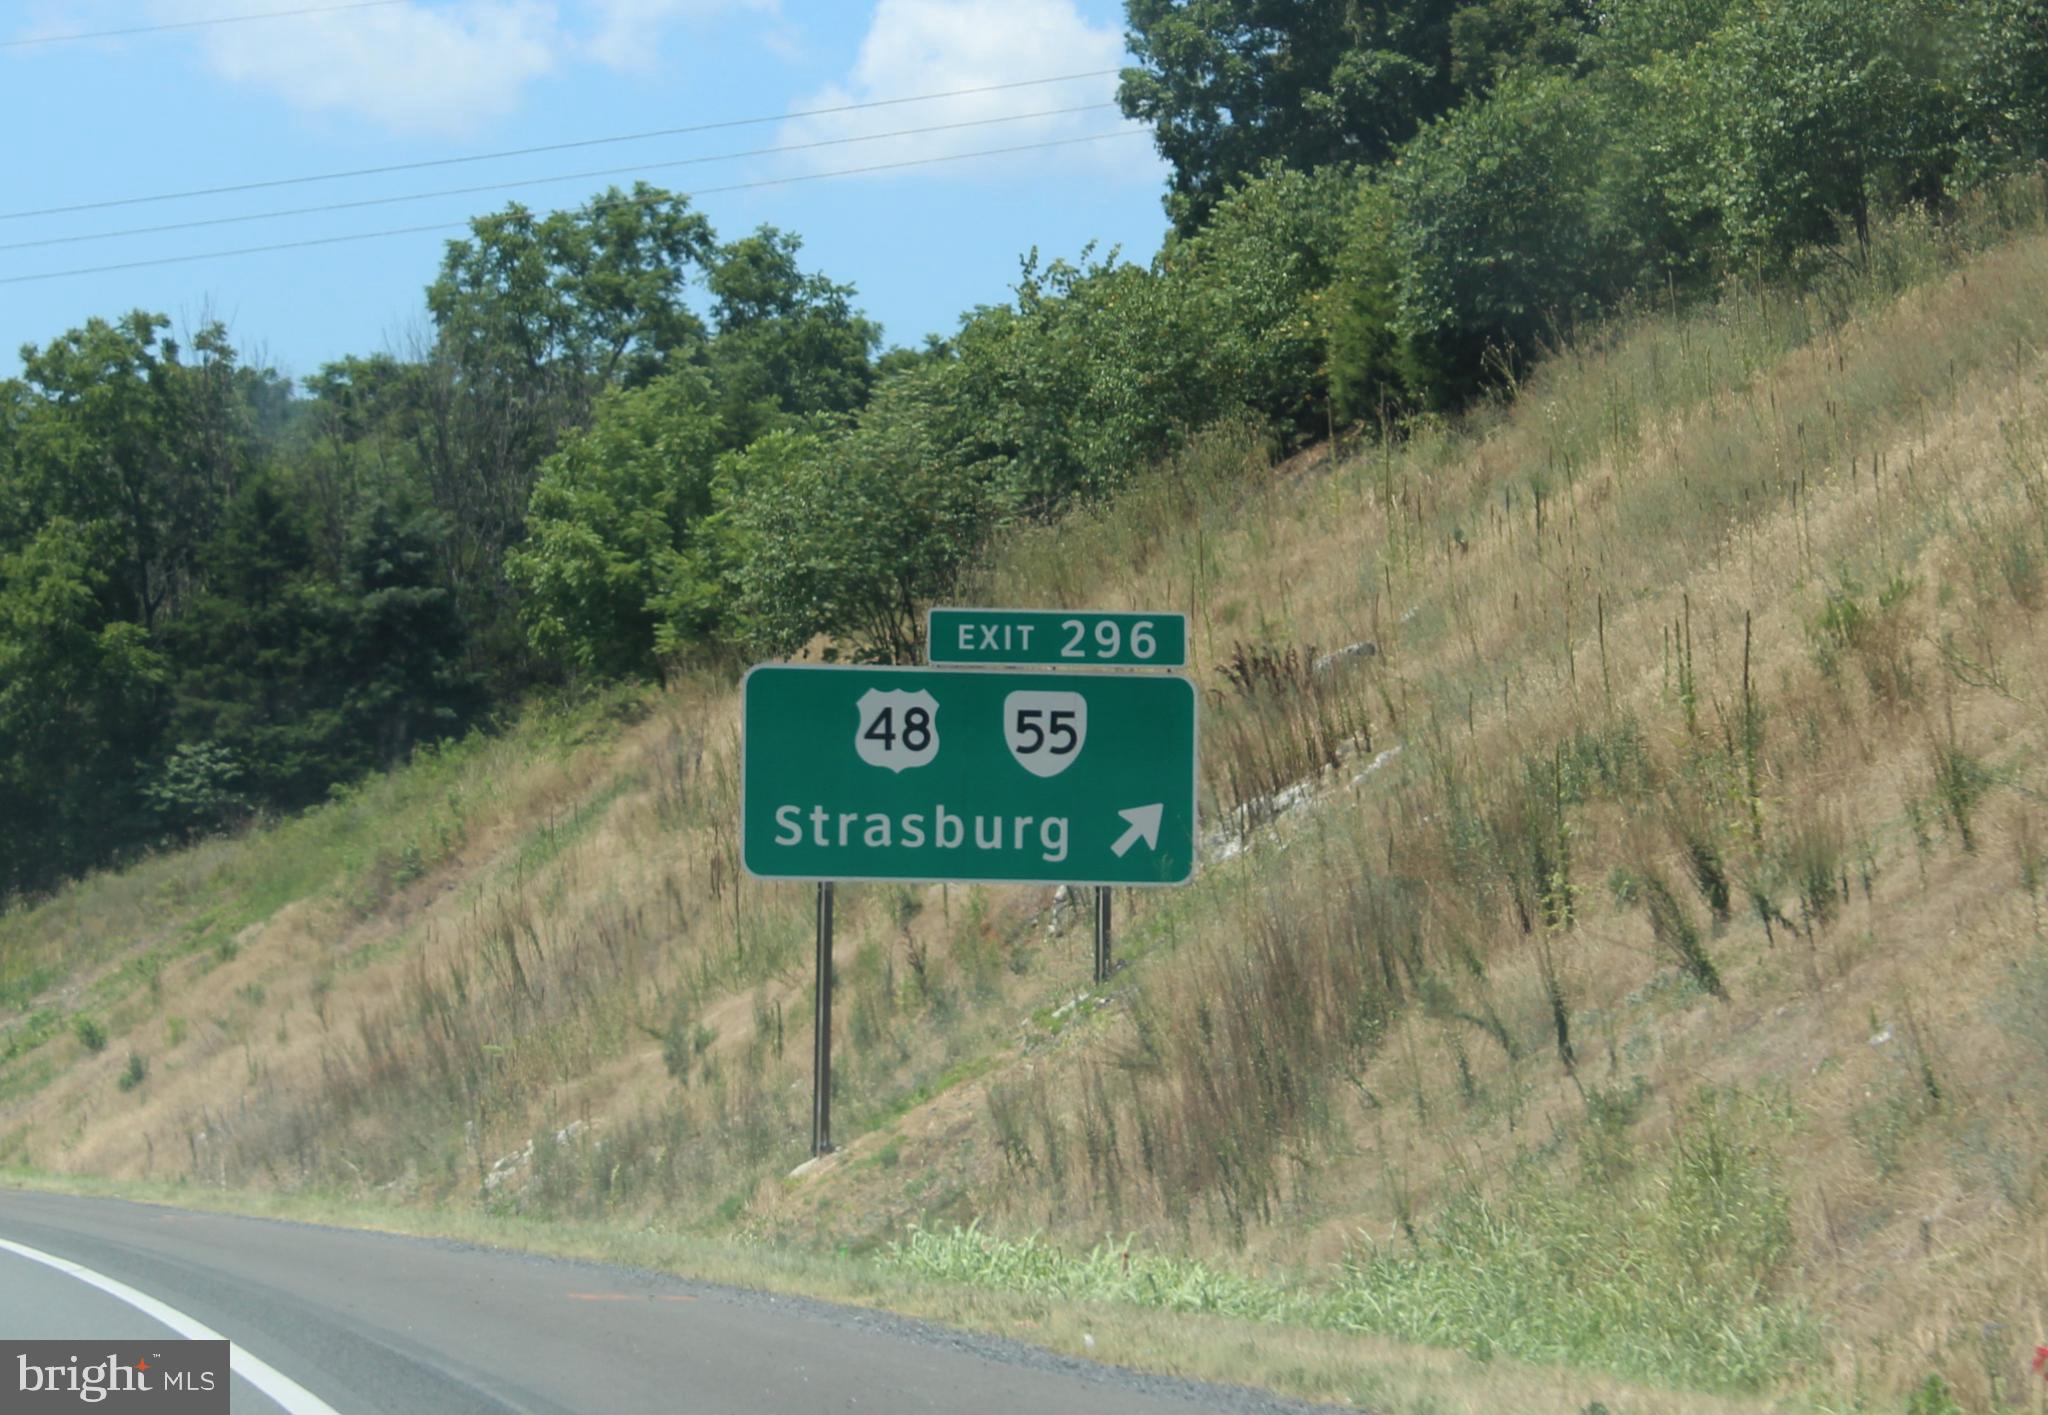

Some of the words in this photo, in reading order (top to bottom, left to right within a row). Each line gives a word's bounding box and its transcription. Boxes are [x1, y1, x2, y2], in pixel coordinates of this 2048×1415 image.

[958, 624, 1035, 651] EXIT
[1060, 619, 1157, 660] 296
[863, 706, 932, 753] 48
[1015, 709, 1078, 756] 55
[774, 804, 1069, 863] Strasburg
